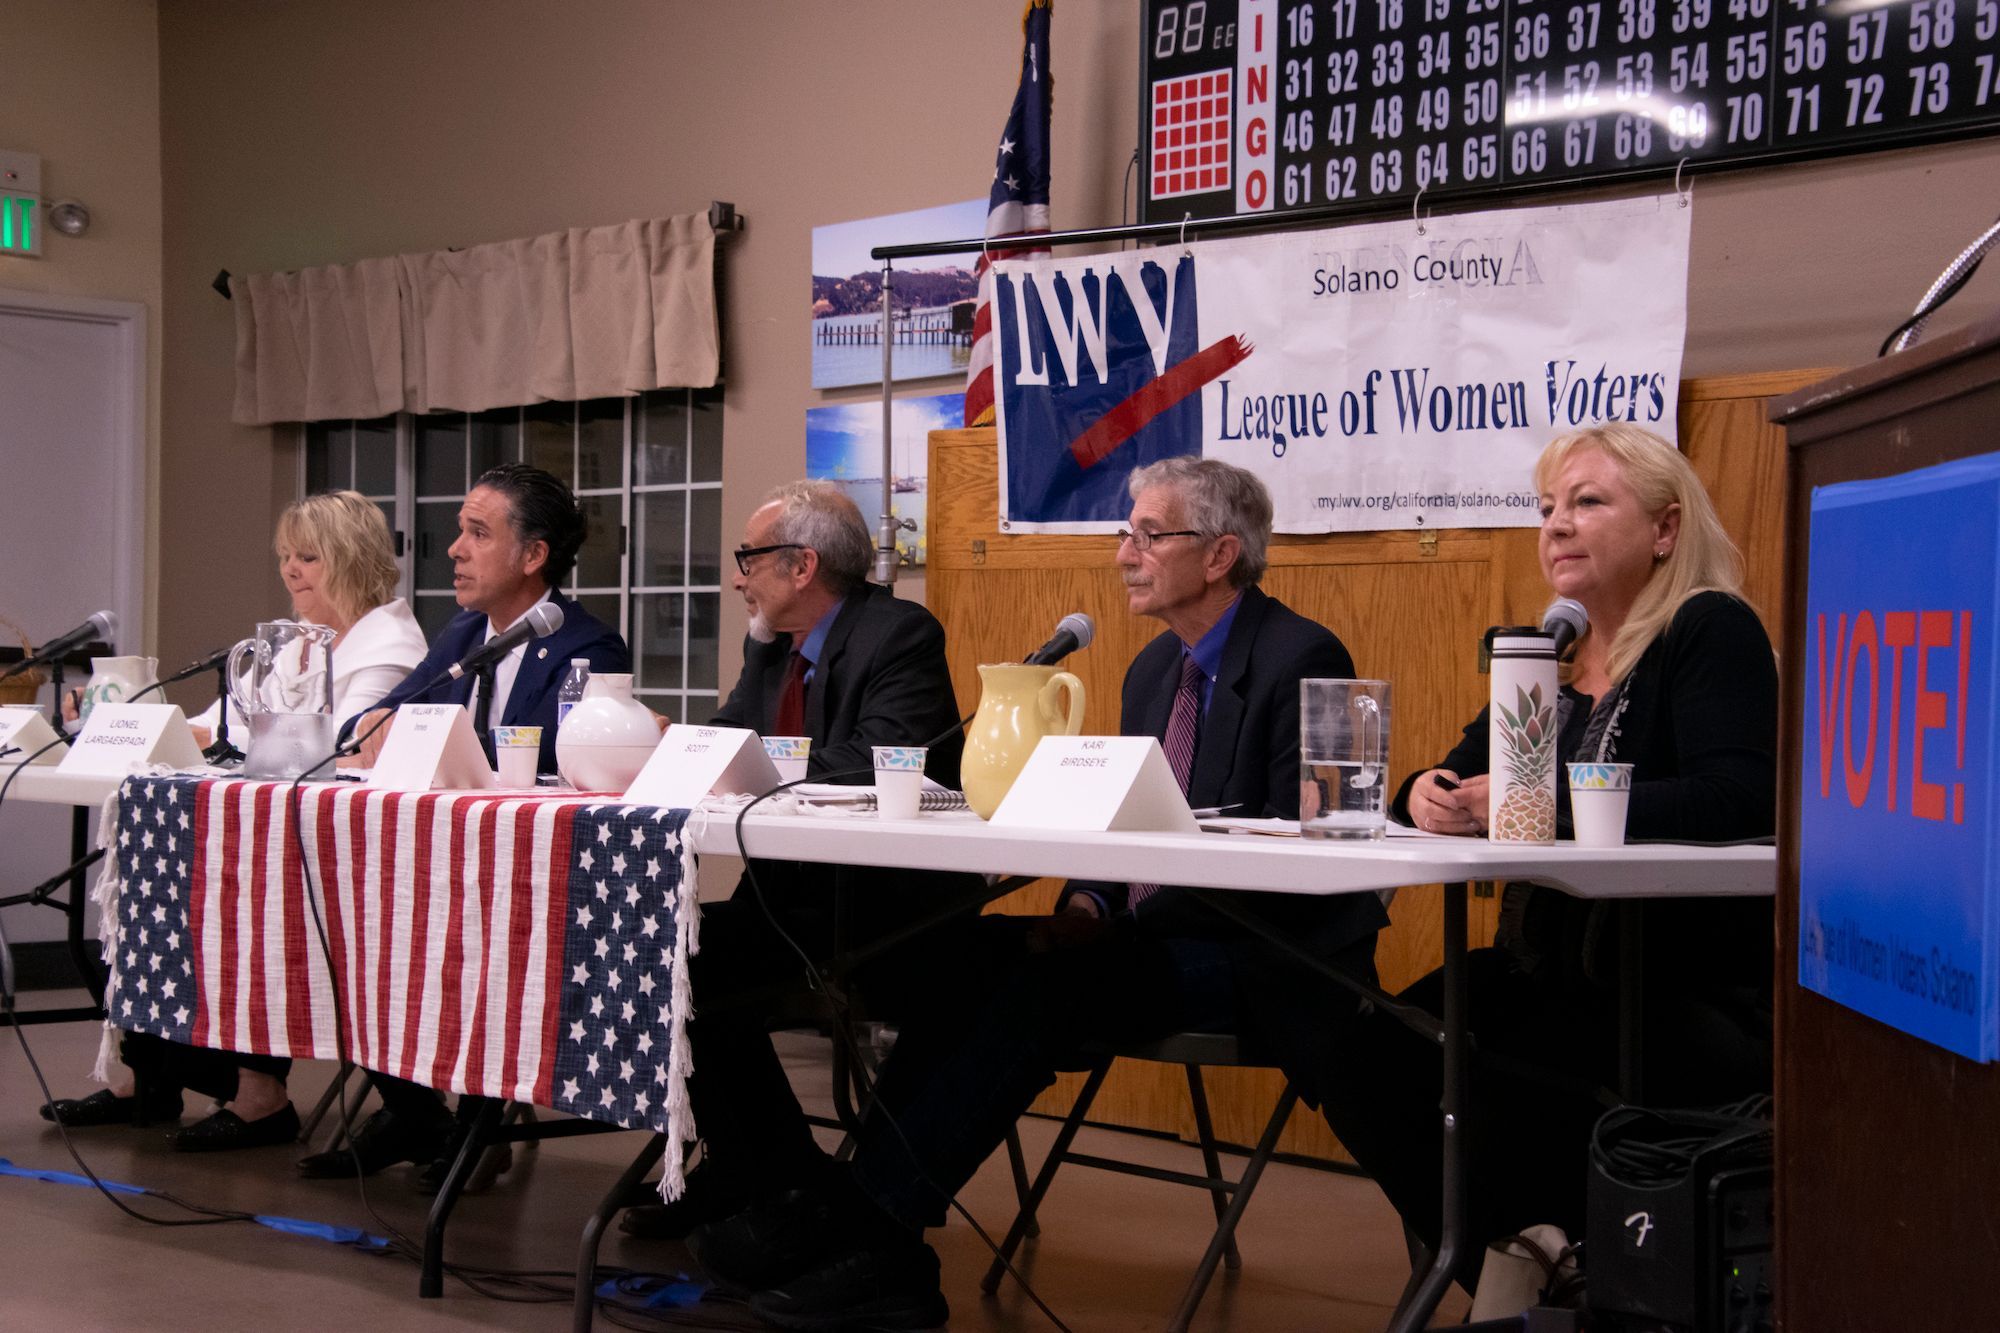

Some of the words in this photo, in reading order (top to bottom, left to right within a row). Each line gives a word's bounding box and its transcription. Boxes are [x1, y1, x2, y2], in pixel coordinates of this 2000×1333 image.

[1286, 4, 1313, 48] 16
[1332, 0, 1357, 40] 17
[1375, 0, 1403, 32] 18
[1285, 57, 1313, 101] 31
[1327, 49, 1359, 94] 32
[1372, 41, 1404, 87] 33
[1418, 31, 1450, 79] 34
[1465, 22, 1499, 70] 35
[1514, 13, 1549, 62] 36
[1567, 3, 1600, 52] 37
[1617, 0, 1655, 43] 38
[1672, 0, 1711, 33] 39
[1282, 110, 1313, 153] 46
[1328, 103, 1357, 146] 47
[1371, 95, 1403, 140] 48
[1416, 87, 1450, 132] 49
[1464, 79, 1498, 126] 50
[1515, 71, 1547, 118] 51
[1563, 61, 1600, 110] 52
[1616, 52, 1653, 102] 53
[1670, 42, 1708, 93] 54
[1726, 31, 1767, 84] 55
[1784, 21, 1827, 75] 56
[1847, 9, 1888, 64] 57
[1908, 0, 1956, 53] 58
[1975, 0, 1999, 41] 5
[1245, 0, 1267, 209] INGO
[1284, 163, 1312, 206] 61
[1326, 156, 1357, 201] 62
[1370, 150, 1402, 195] 63
[1416, 142, 1448, 188] 64
[1463, 135, 1497, 181] 65
[1511, 127, 1547, 175] 66
[1564, 119, 1597, 167] 67
[1615, 111, 1651, 160] 68
[1668, 102, 1707, 152] 69
[1727, 93, 1762, 143] 70
[1786, 84, 1820, 136] 71
[1845, 73, 1884, 127] 72
[1909, 62, 1949, 117] 73
[1975, 54, 2000, 106] 7
[0, 195, 36, 251] IT
[1313, 265, 1399, 296] Solano
[1413, 254, 1502, 286] County
[1003, 258, 1184, 387] LWV
[1218, 380, 1328, 458] League
[1339, 369, 1382, 437] of
[1390, 368, 1530, 434] Women
[1544, 360, 1665, 427] Voters
[1317, 490, 1540, 511] my.lwv.org/california/solano-coun
[84, 735, 146, 747] LARGAESPADA
[109, 720, 139, 729] LIONEL
[697, 728, 719, 737] TERRY
[1818, 610, 1973, 825] VOTE!
[684, 743, 709, 753] SCOTT
[1060, 757, 1108, 767] BIRDSEYE
[1081, 740, 1106, 749] KARI
